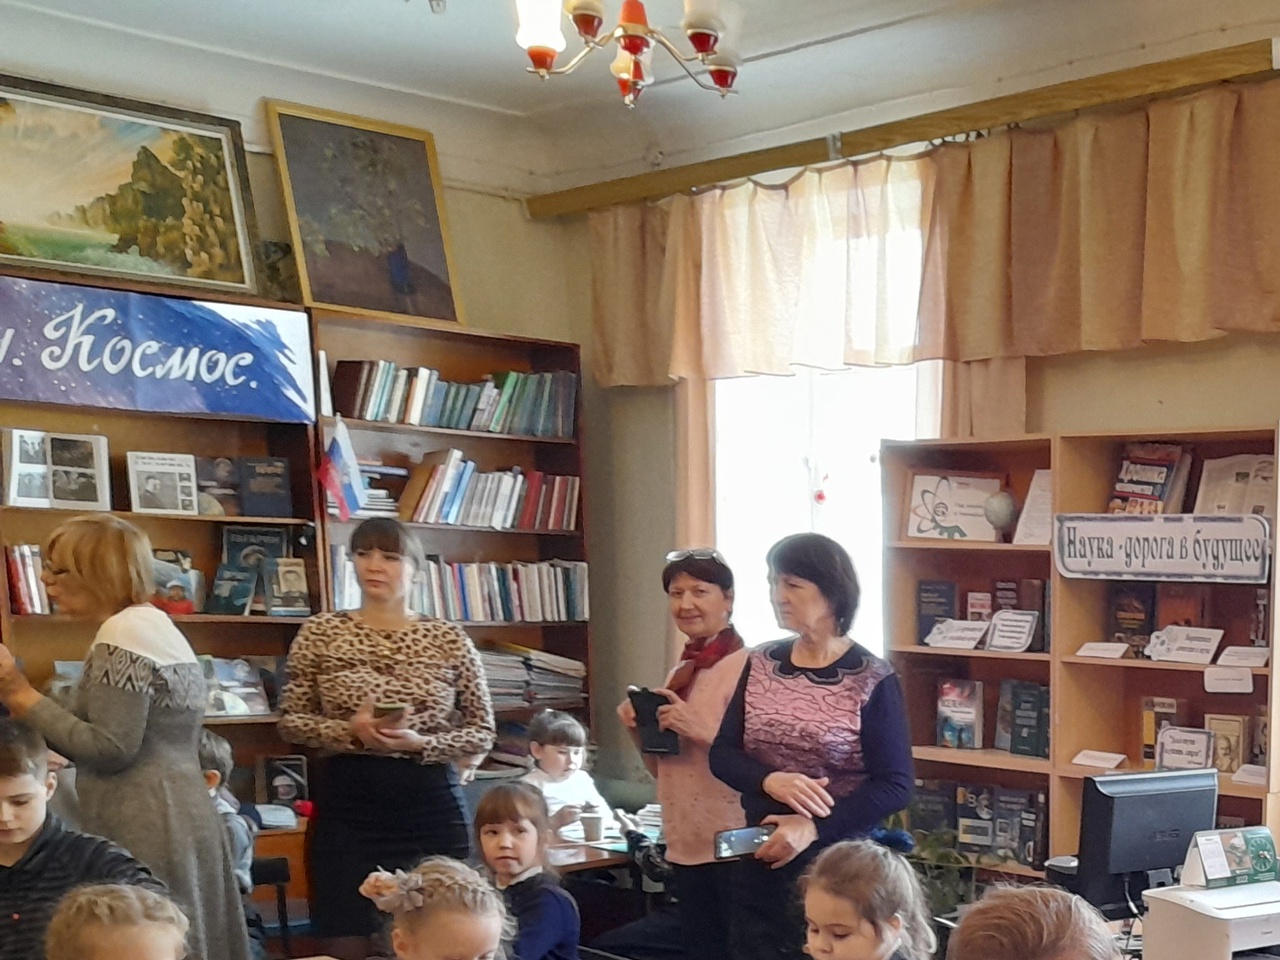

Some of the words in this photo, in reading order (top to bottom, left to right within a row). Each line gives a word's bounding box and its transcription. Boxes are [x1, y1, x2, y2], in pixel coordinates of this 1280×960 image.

[41, 303, 258, 389] Космос.
[1066, 526, 1114, 567] Наука
[1179, 536, 1188, 560] в
[1193, 529, 1260, 570] будущее
